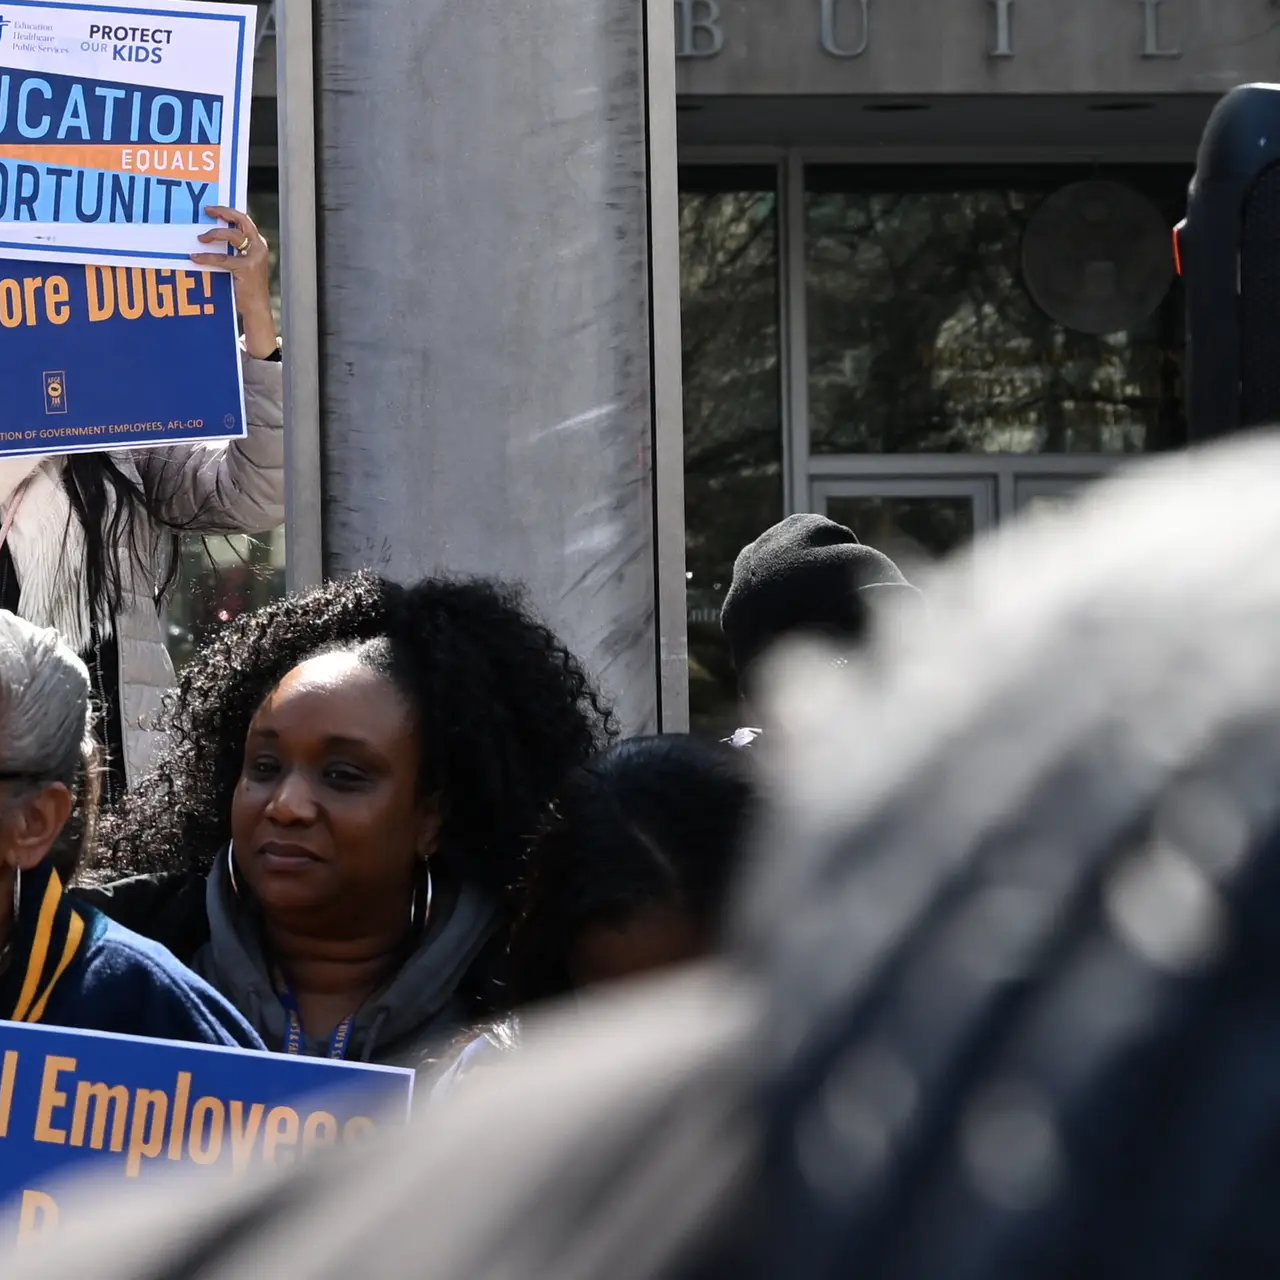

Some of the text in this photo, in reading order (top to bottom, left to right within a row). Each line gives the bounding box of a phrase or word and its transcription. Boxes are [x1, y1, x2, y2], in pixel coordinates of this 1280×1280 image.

[90, 24, 173, 45] PROTECT
[81, 41, 162, 64] OUR KIDS
[121, 149, 216, 172] EQUALS
[85, 264, 215, 321] DOGE!
[24, 430, 38, 440] OF
[39, 425, 107, 438] GOVERNMENT
[108, 422, 165, 434] EMPLOYEES,
[167, 418, 204, 430] AFL-CIO
